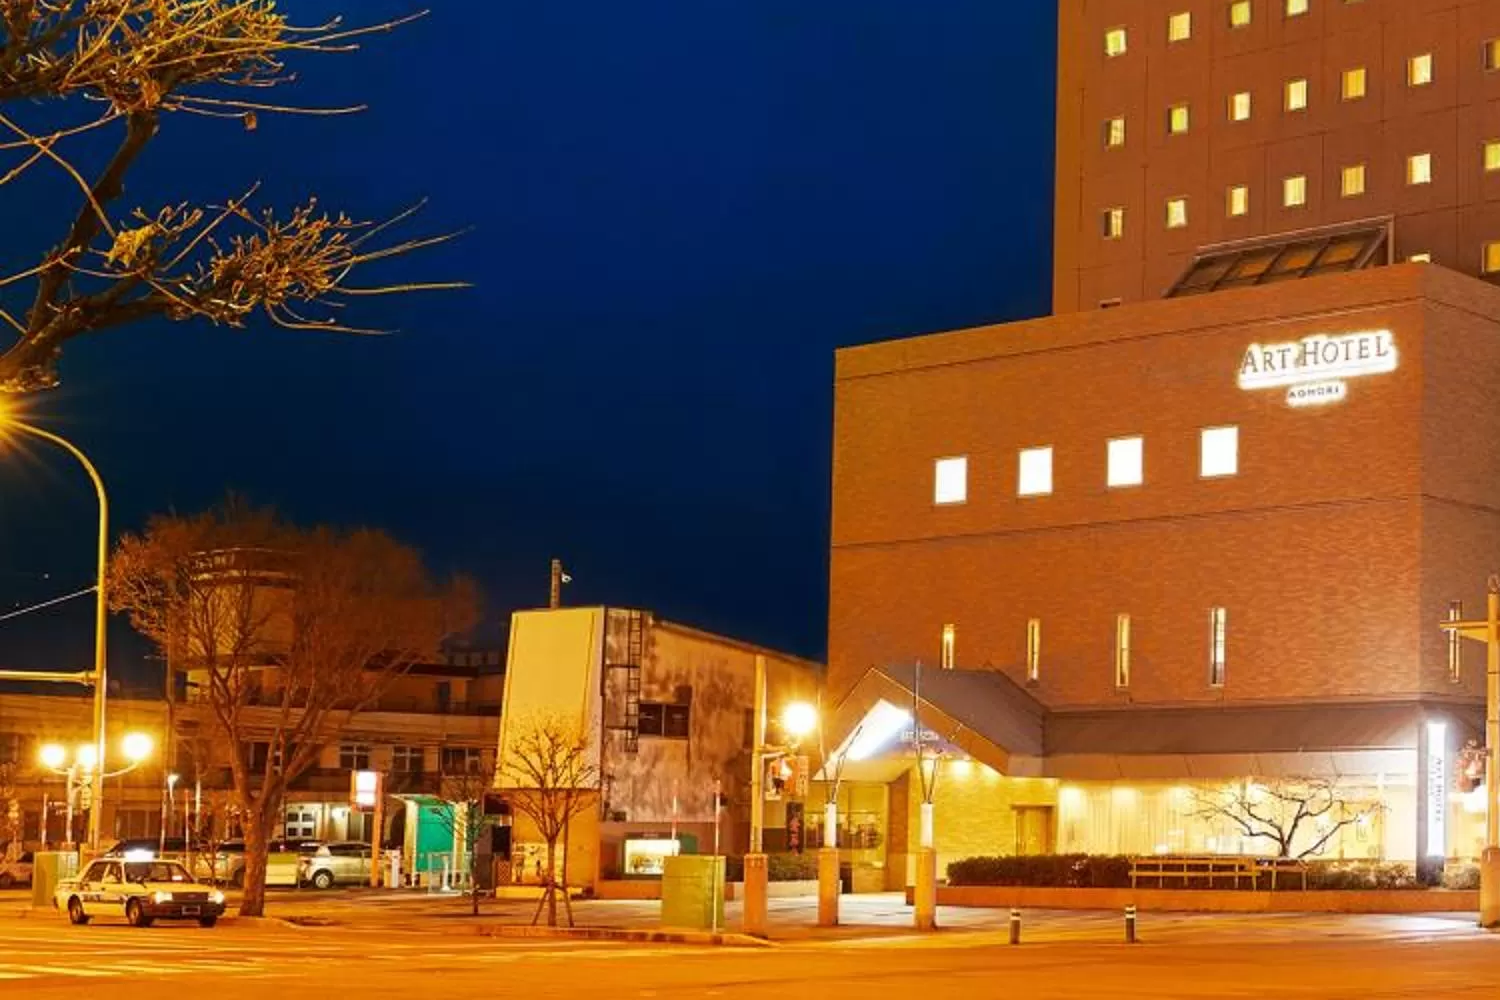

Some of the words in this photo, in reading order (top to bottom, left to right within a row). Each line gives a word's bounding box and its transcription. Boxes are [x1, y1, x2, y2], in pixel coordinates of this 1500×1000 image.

[1241, 347, 1291, 375] ART
[1302, 335, 1389, 367] HOTEL
[1288, 385, 1340, 399] AOMORI
